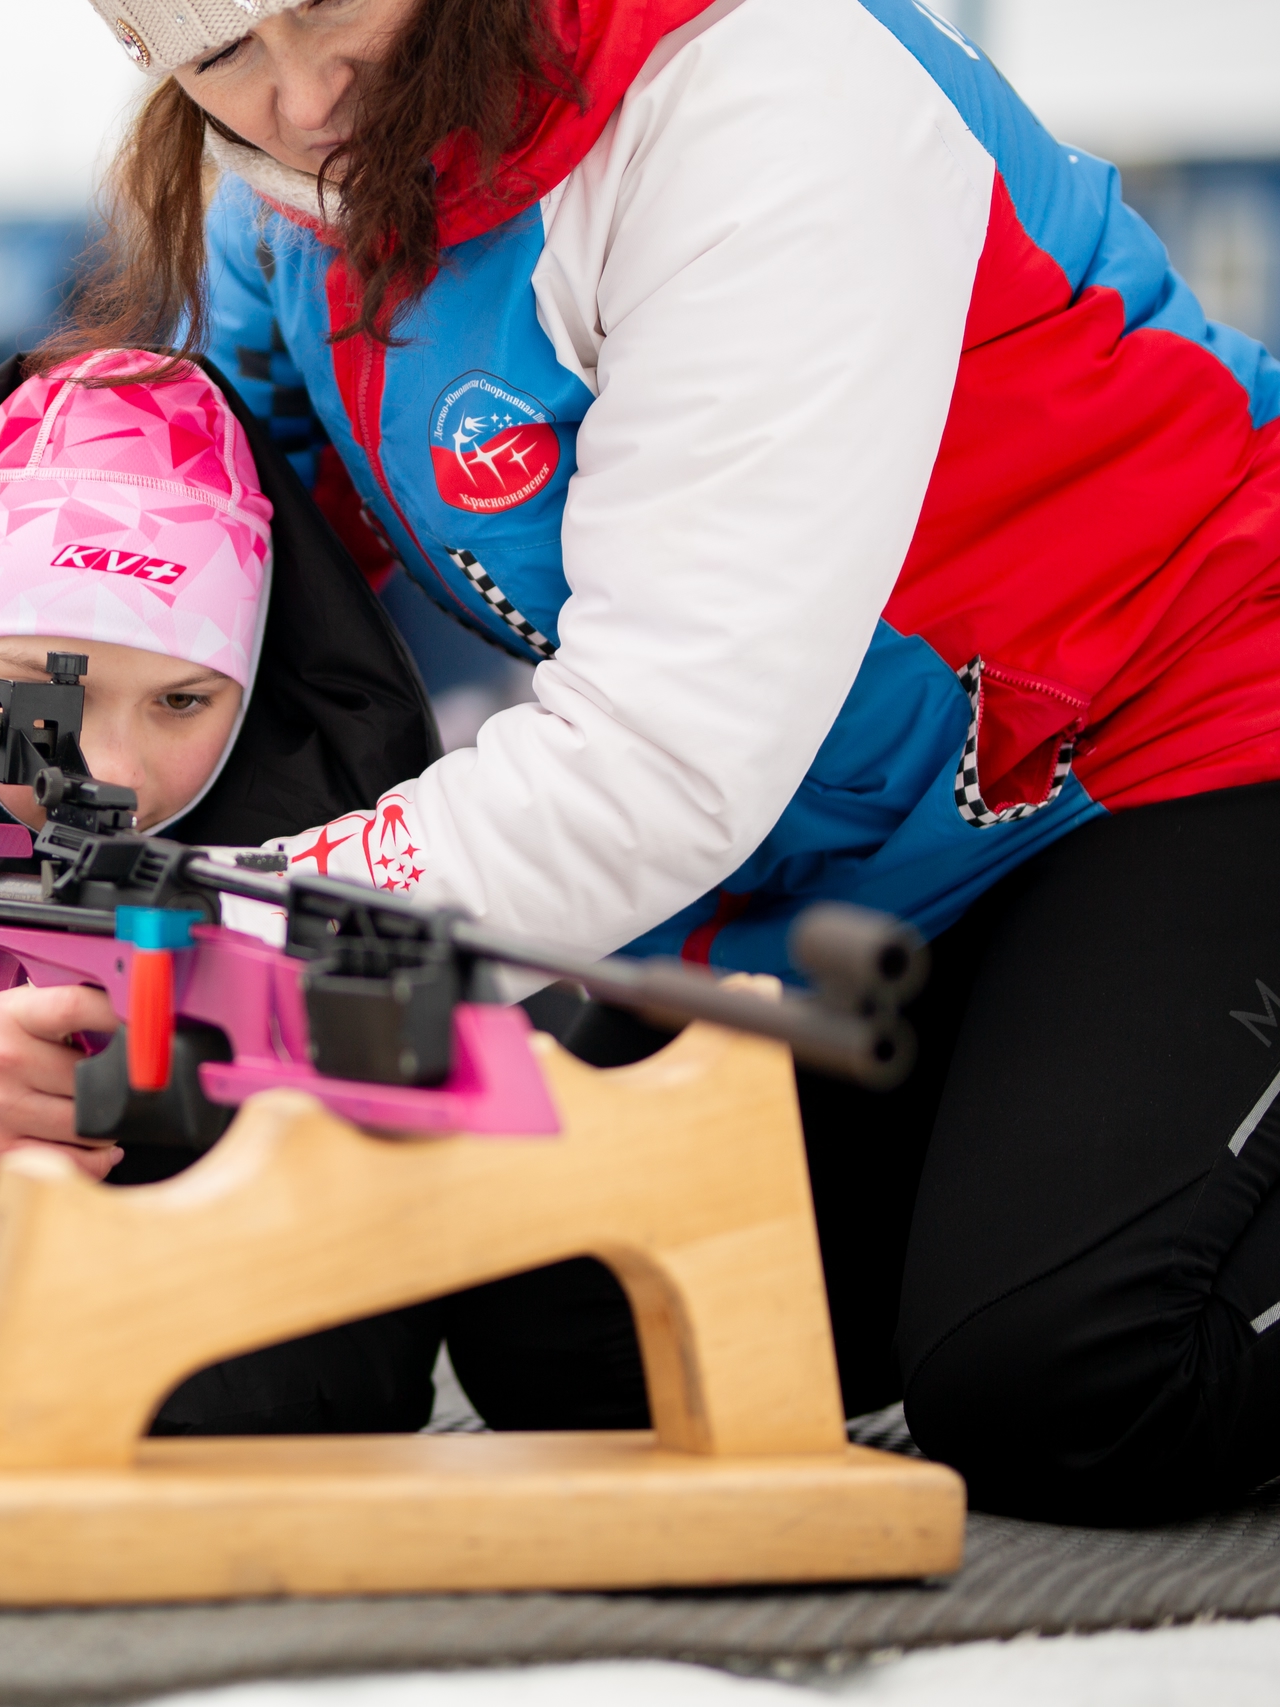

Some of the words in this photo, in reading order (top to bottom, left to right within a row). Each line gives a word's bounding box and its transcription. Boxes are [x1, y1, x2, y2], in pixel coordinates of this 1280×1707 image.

[480, 379, 535, 417] Спортивная
[459, 463, 550, 510] Краснознаменск
[53, 545, 181, 581] KV+
